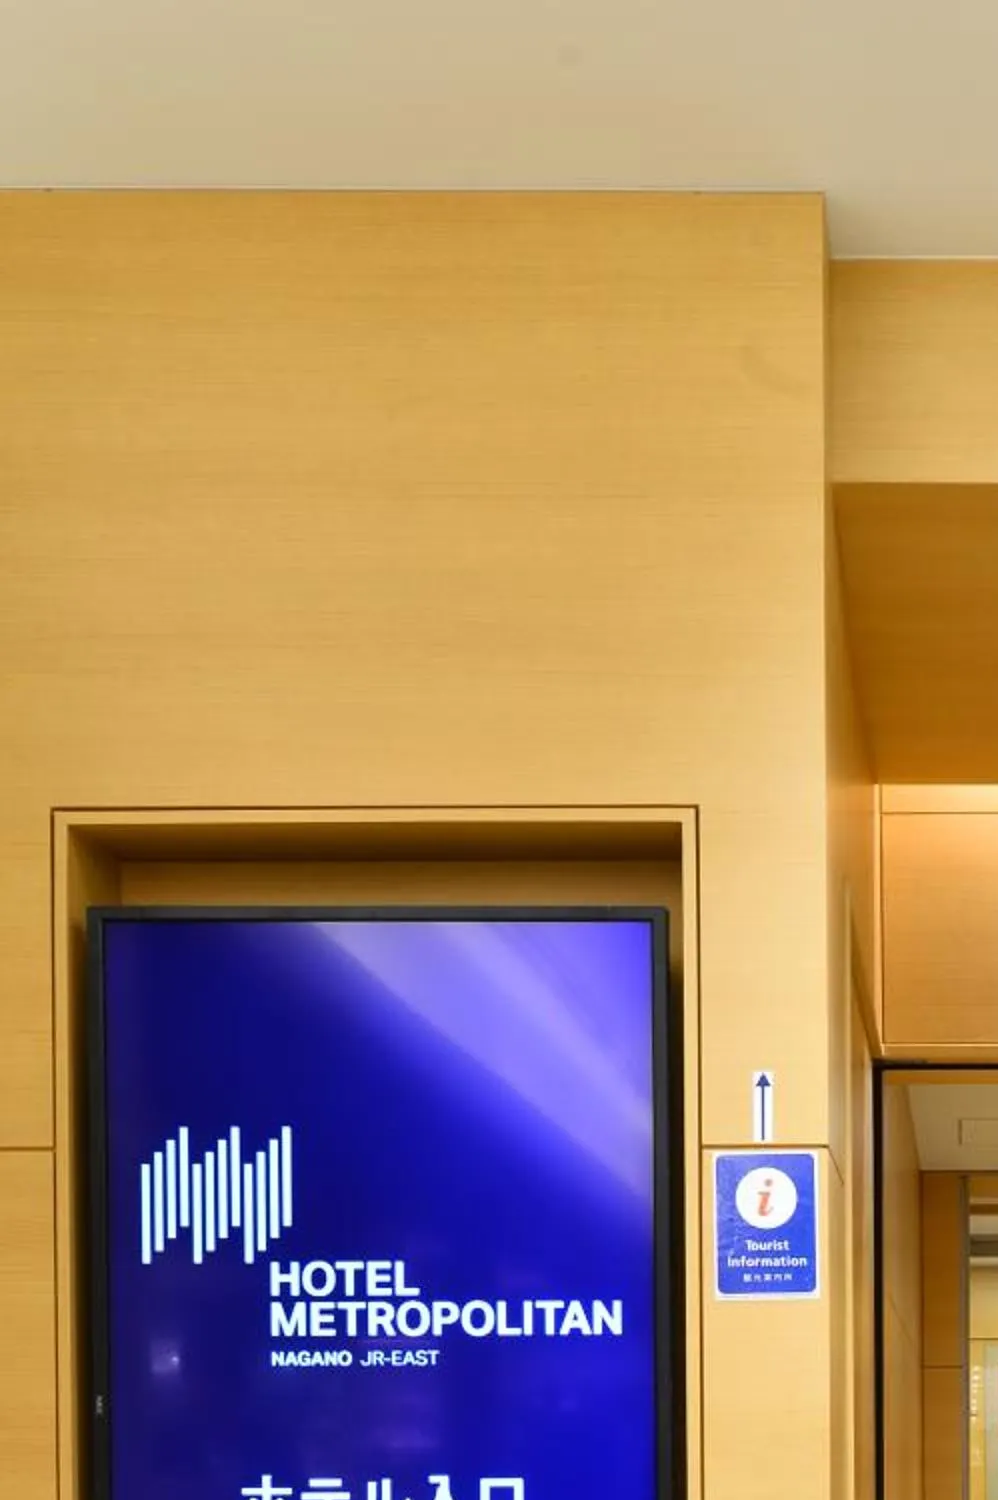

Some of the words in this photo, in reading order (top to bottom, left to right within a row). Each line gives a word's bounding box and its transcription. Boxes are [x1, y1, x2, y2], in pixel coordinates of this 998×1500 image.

[745, 1239, 790, 1252] Tourist
[269, 1261, 419, 1297] HOTEL
[269, 1300, 623, 1337] METROPOLITAN
[271, 1351, 353, 1367] NAGANO
[359, 1349, 440, 1366] JR-EAST
